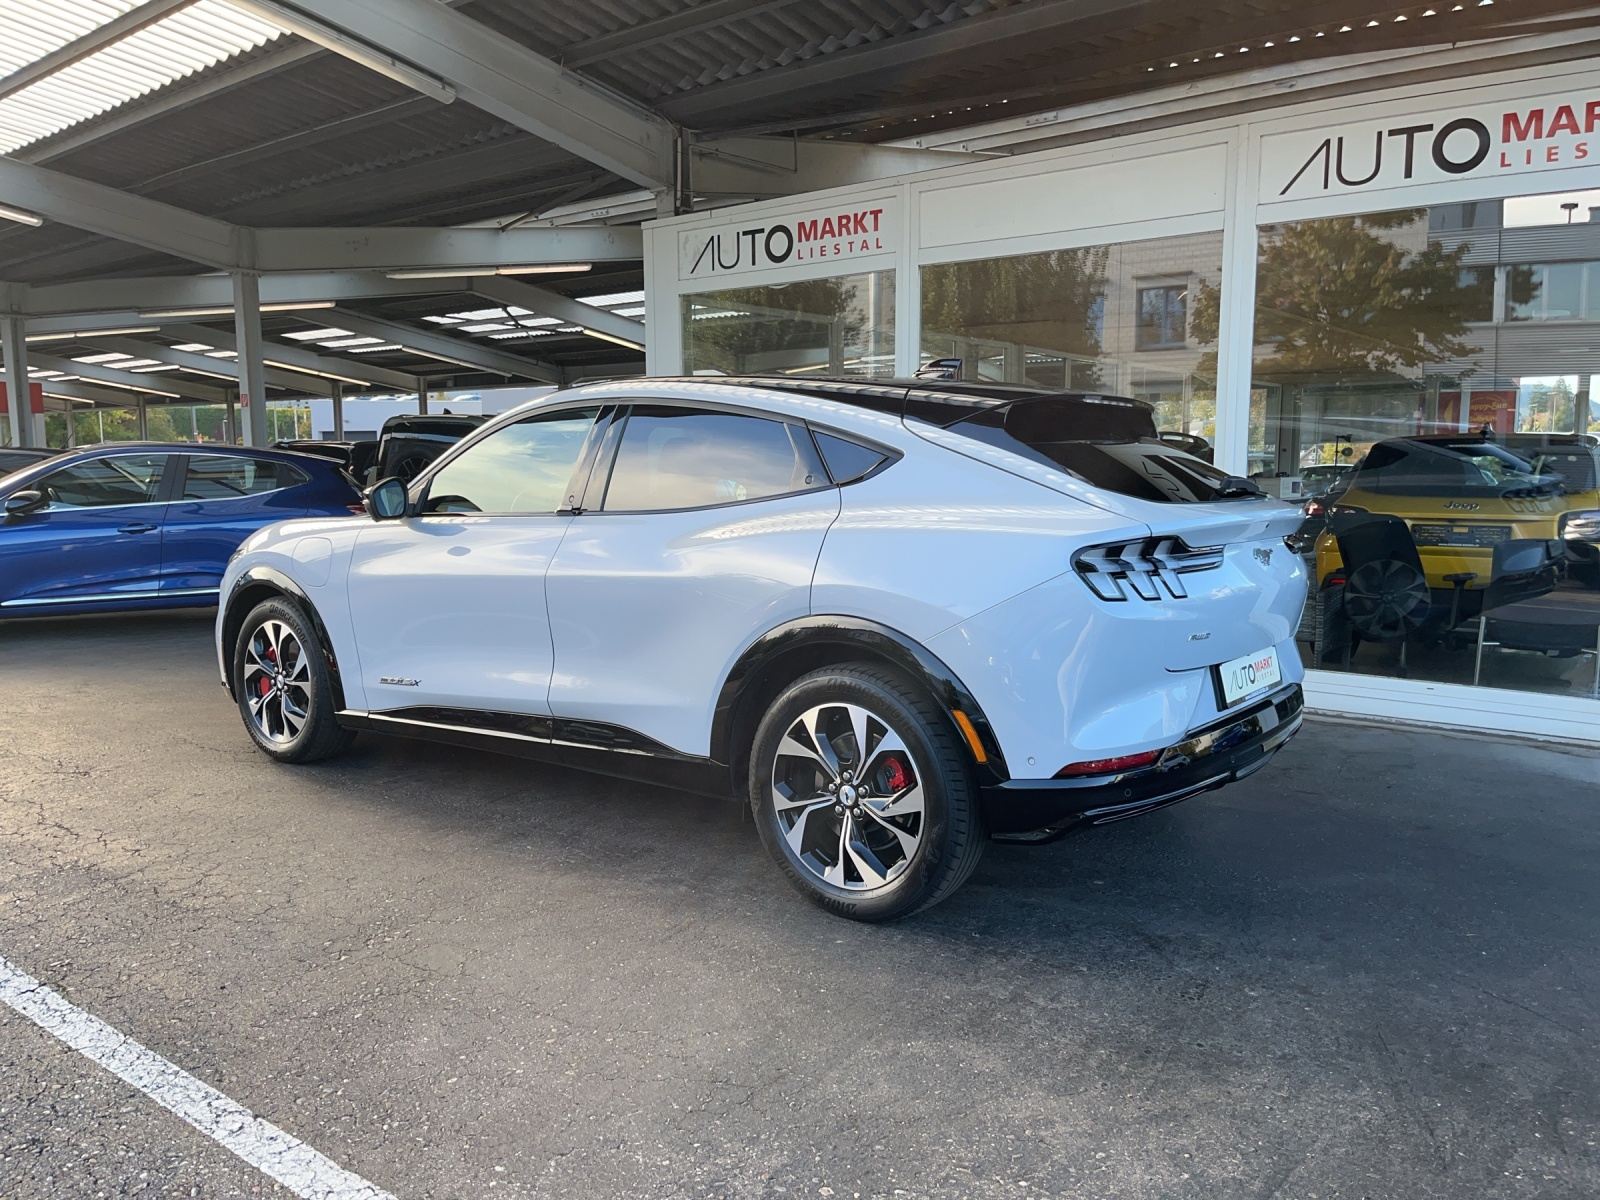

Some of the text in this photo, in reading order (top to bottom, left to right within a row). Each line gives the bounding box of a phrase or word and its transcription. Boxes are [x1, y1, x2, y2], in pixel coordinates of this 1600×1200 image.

[1279, 117, 1491, 196] AUTO
[1500, 141, 1589, 169] LIES
[690, 208, 883, 275] AUTO MARKT
[797, 236, 883, 261] LIESTAL
[1471, 401, 1508, 411] appy-Sun
[1443, 500, 1480, 511] Jeep
[1230, 655, 1273, 693] AUTO MARKT
[1256, 669, 1276, 682] LIESTAL
